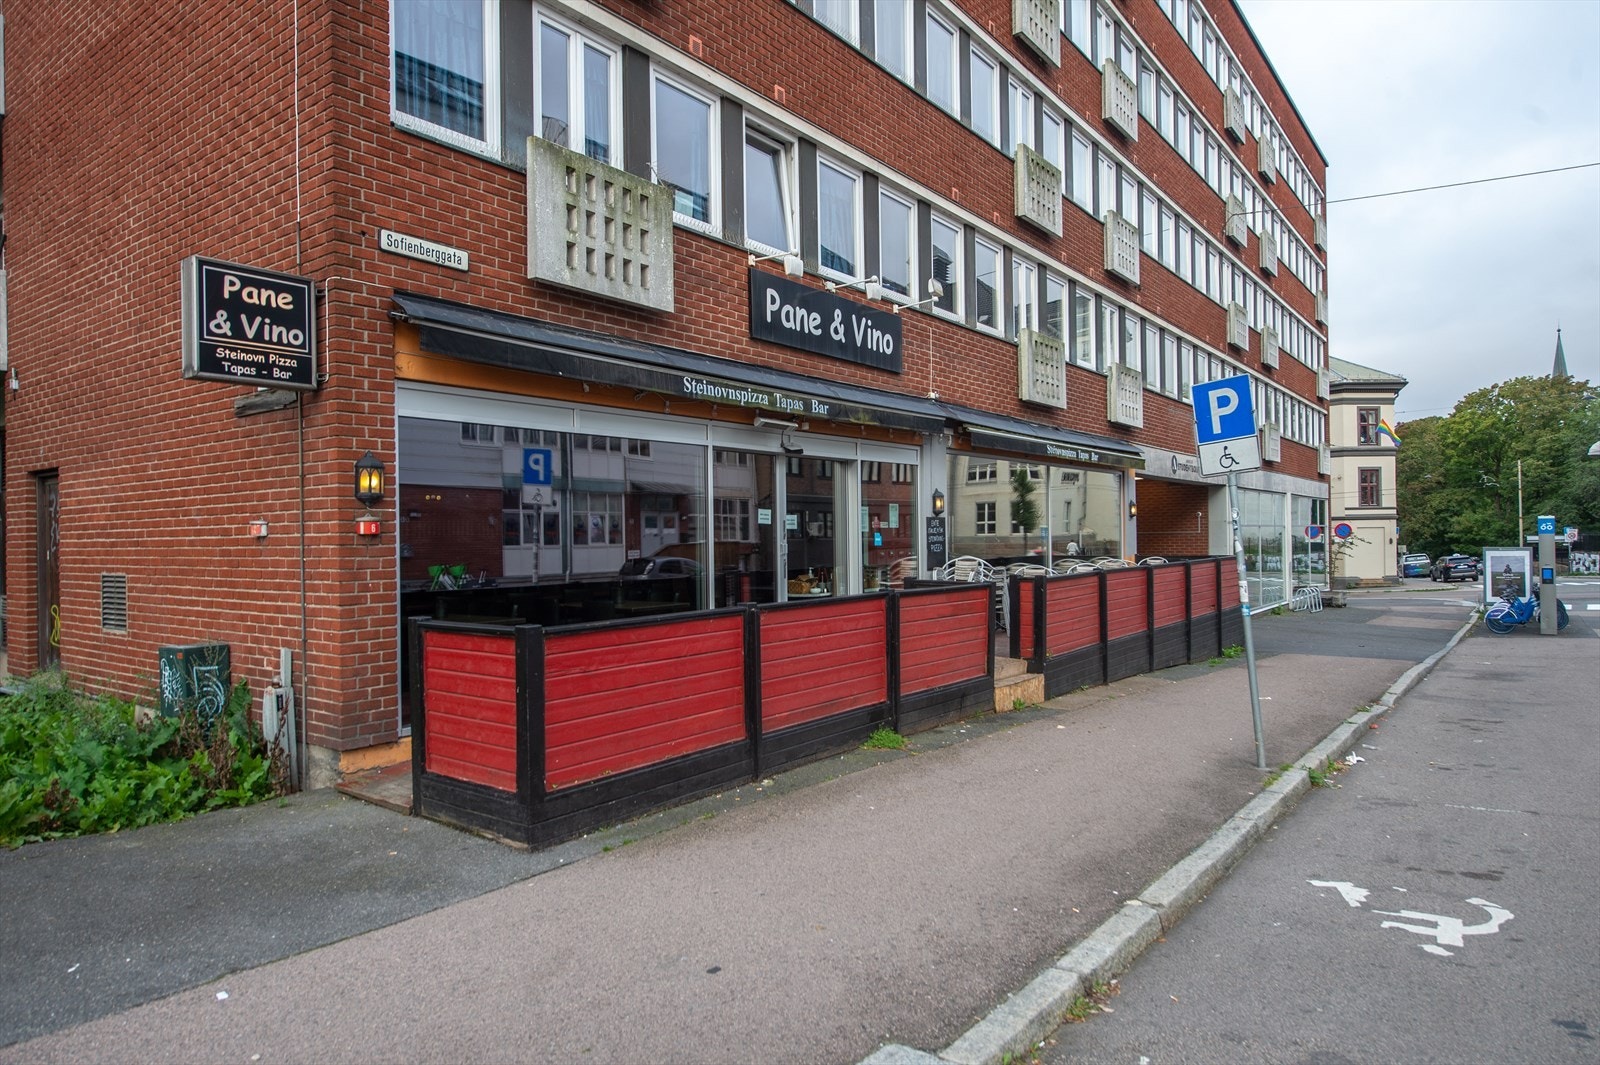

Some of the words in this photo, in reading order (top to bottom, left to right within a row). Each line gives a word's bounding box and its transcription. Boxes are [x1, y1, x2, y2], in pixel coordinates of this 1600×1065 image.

[387, 233, 462, 265] Sofienberggata
[223, 275, 294, 311] Pane
[209, 309, 233, 336] &
[240, 313, 304, 346] Vino
[766, 287, 822, 336] Pane
[830, 308, 846, 344] &
[851, 314, 894, 355] Vino
[215, 347, 265, 363] Steinovn
[269, 354, 298, 368] Pizza
[221, 361, 257, 377] Tapas
[273, 368, 293, 379] Bar
[683, 376, 769, 405] Steinovnspizza
[774, 392, 804, 412] Tapas
[811, 399, 830, 415] Bar
[1208, 387, 1239, 435] P
